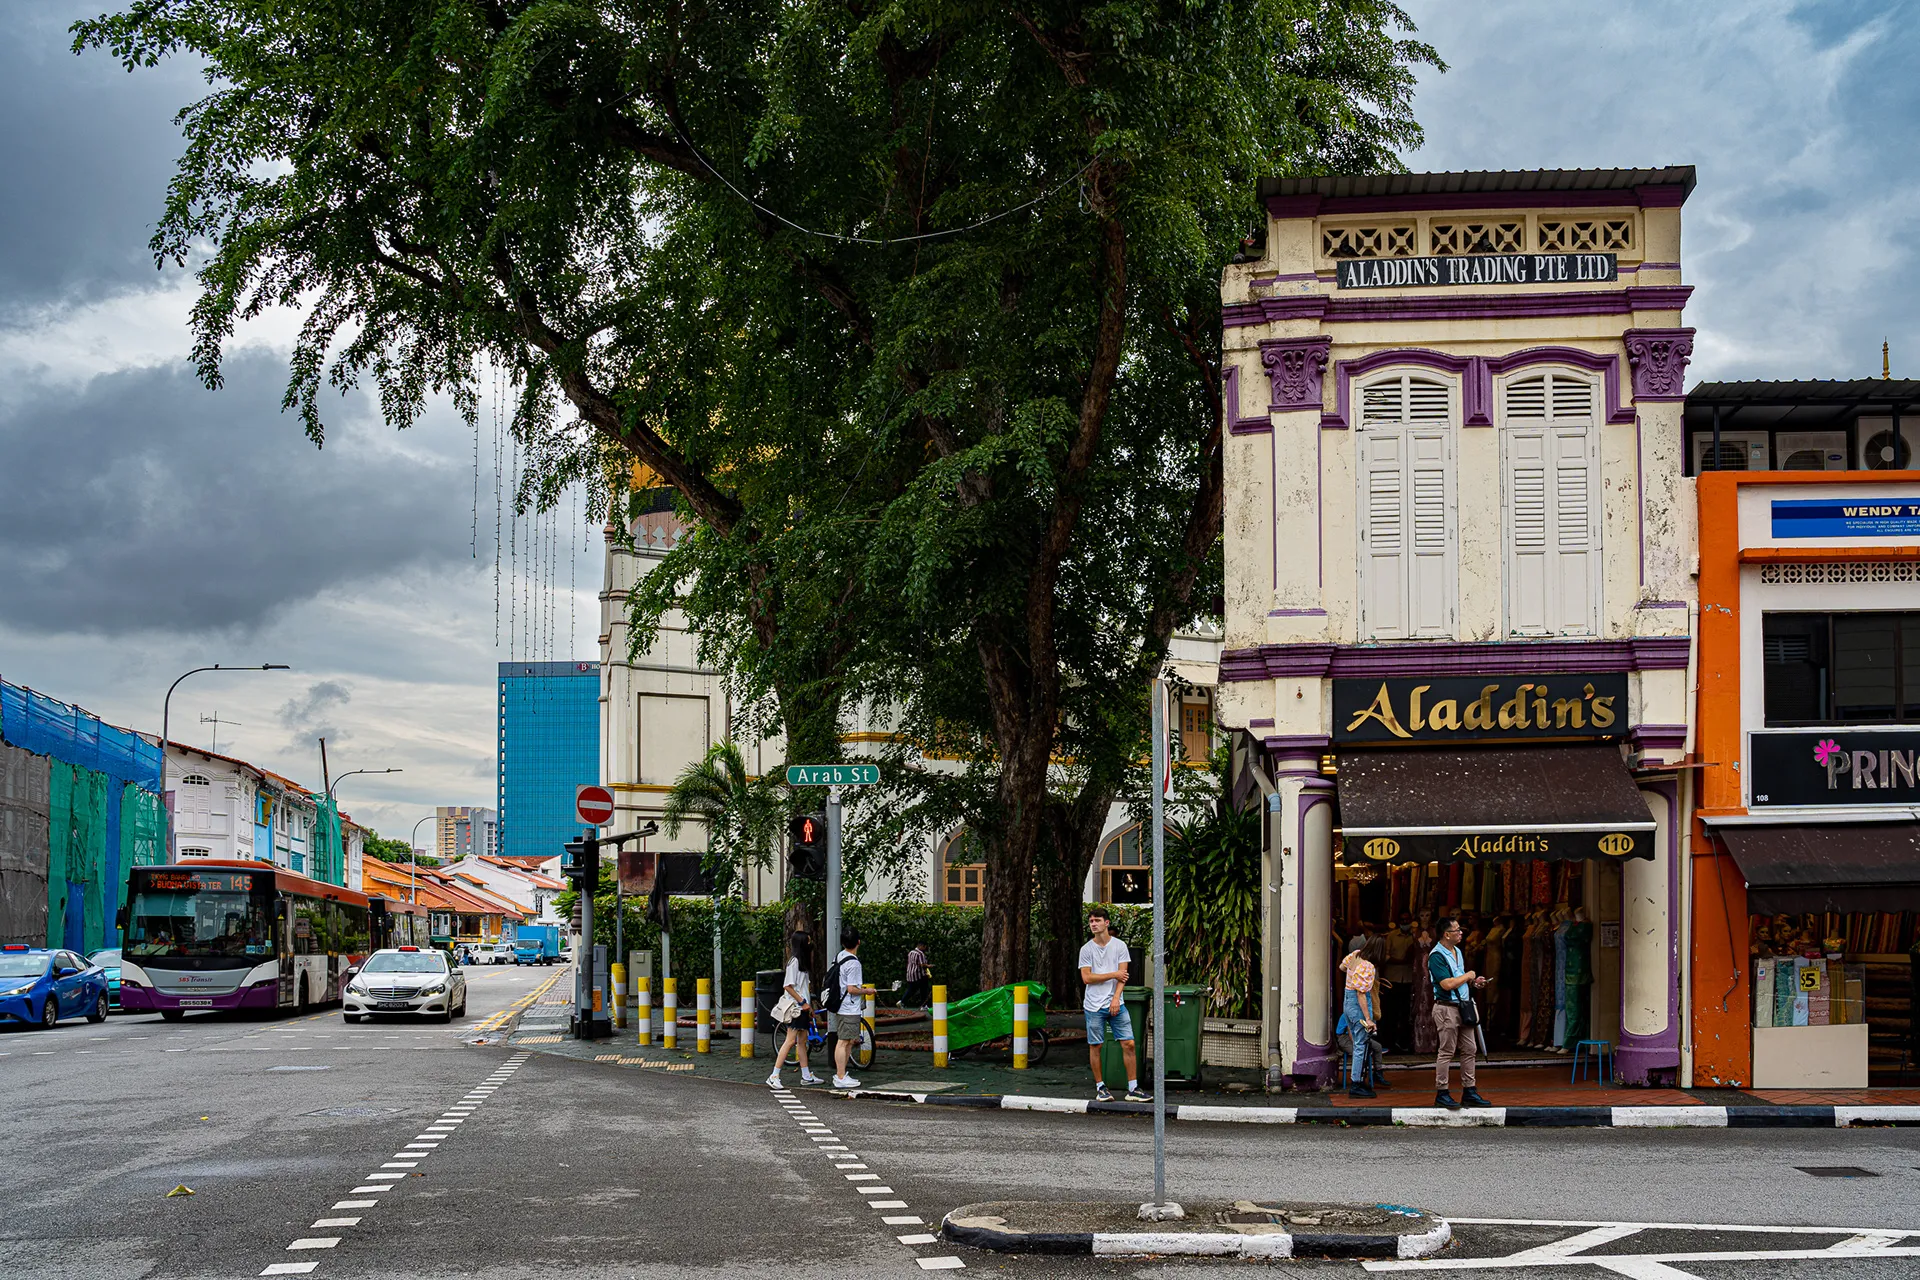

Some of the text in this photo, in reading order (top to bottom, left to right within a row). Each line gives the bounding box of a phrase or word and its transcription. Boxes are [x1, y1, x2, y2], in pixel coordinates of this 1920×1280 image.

[1345, 254, 1610, 288] ALADDIN'S TRADING PTE LTD
[1842, 506, 1902, 517] WENDY
[1346, 681, 1617, 739] Aladdin's
[797, 767, 870, 784] Arab St
[1827, 749, 1920, 790] PRIN
[1756, 794, 1769, 802] 108
[1368, 841, 1396, 857] 110
[1452, 834, 1549, 859] Aladdin's
[1602, 836, 1631, 852] 110
[156, 880, 222, 890] BUONA VISTA TER
[230, 875, 253, 891] 145
[1801, 973, 1816, 987] $5
